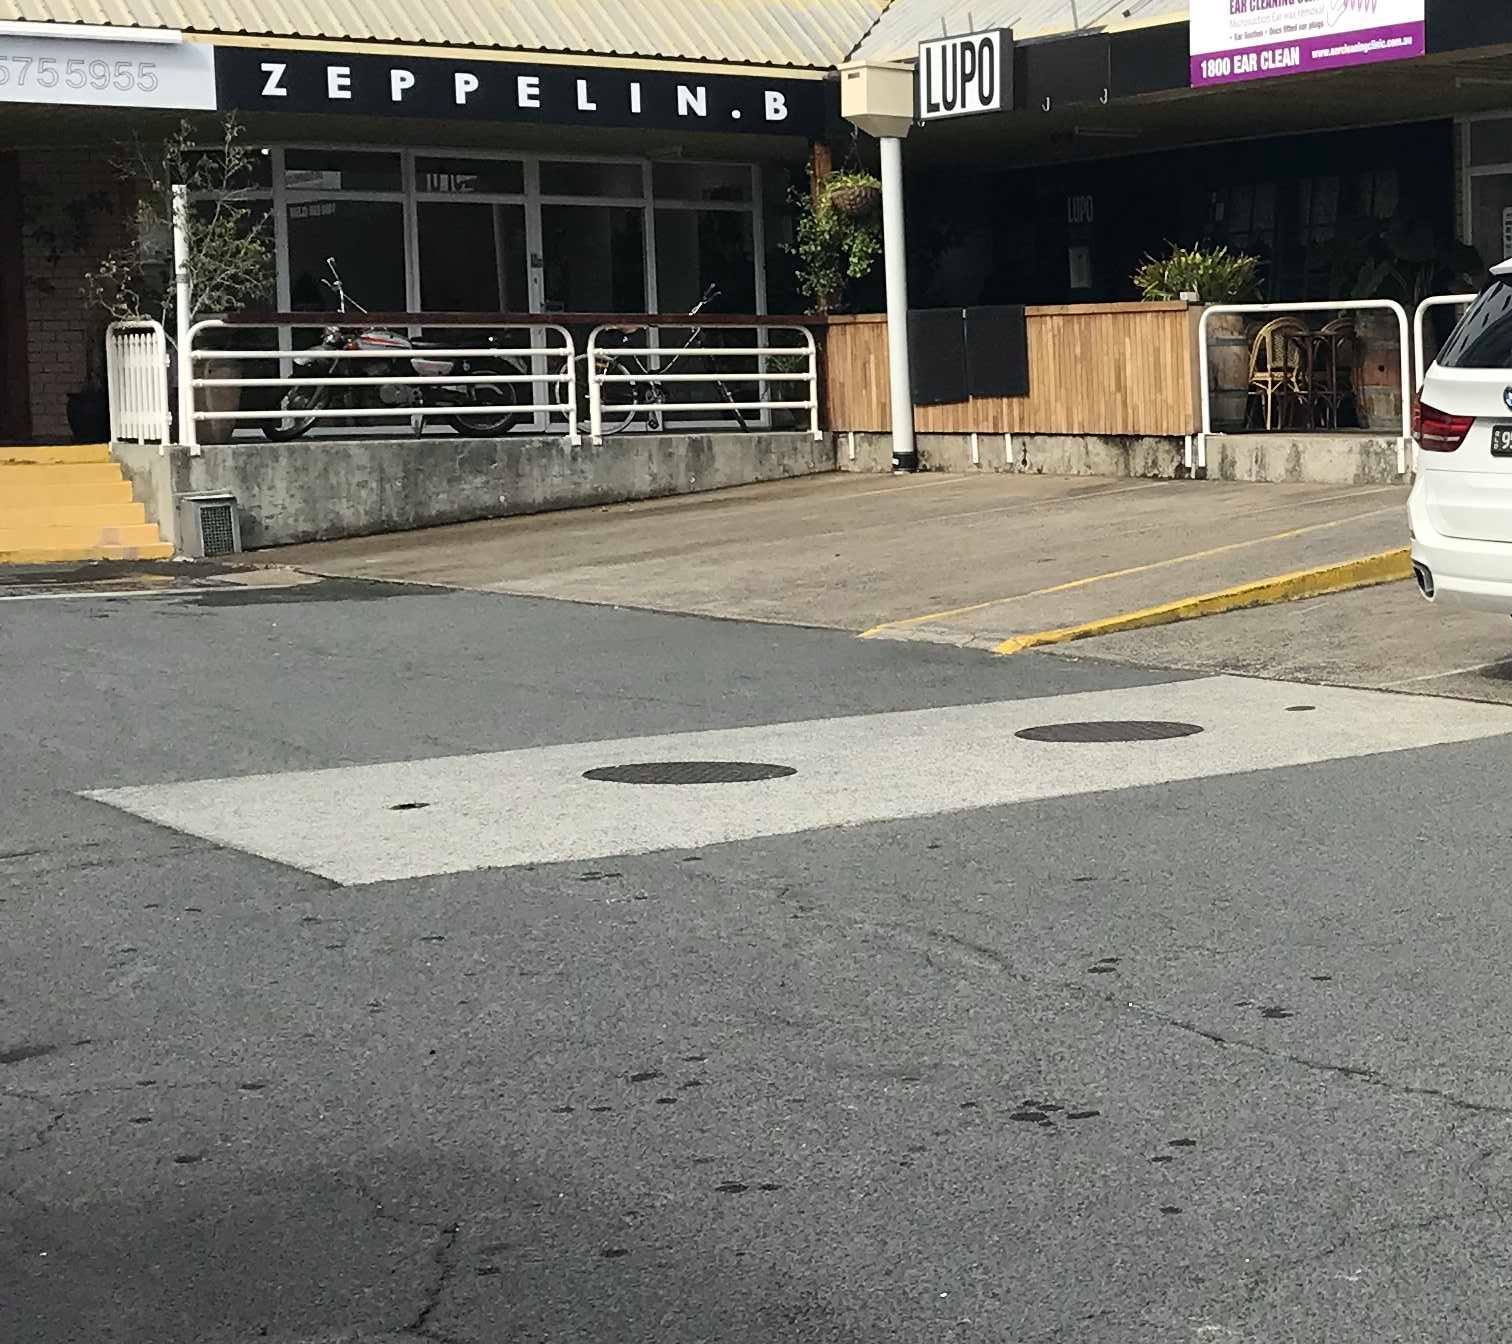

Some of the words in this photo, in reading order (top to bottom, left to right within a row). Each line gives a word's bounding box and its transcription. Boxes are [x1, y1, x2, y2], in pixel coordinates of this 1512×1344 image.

[926, 36, 995, 114] LUPO
[1200, 58, 1231, 79] 1800
[1234, 52, 1258, 74] EAR
[1261, 46, 1300, 70] CLEAN
[1066, 194, 1094, 224] LUPO
